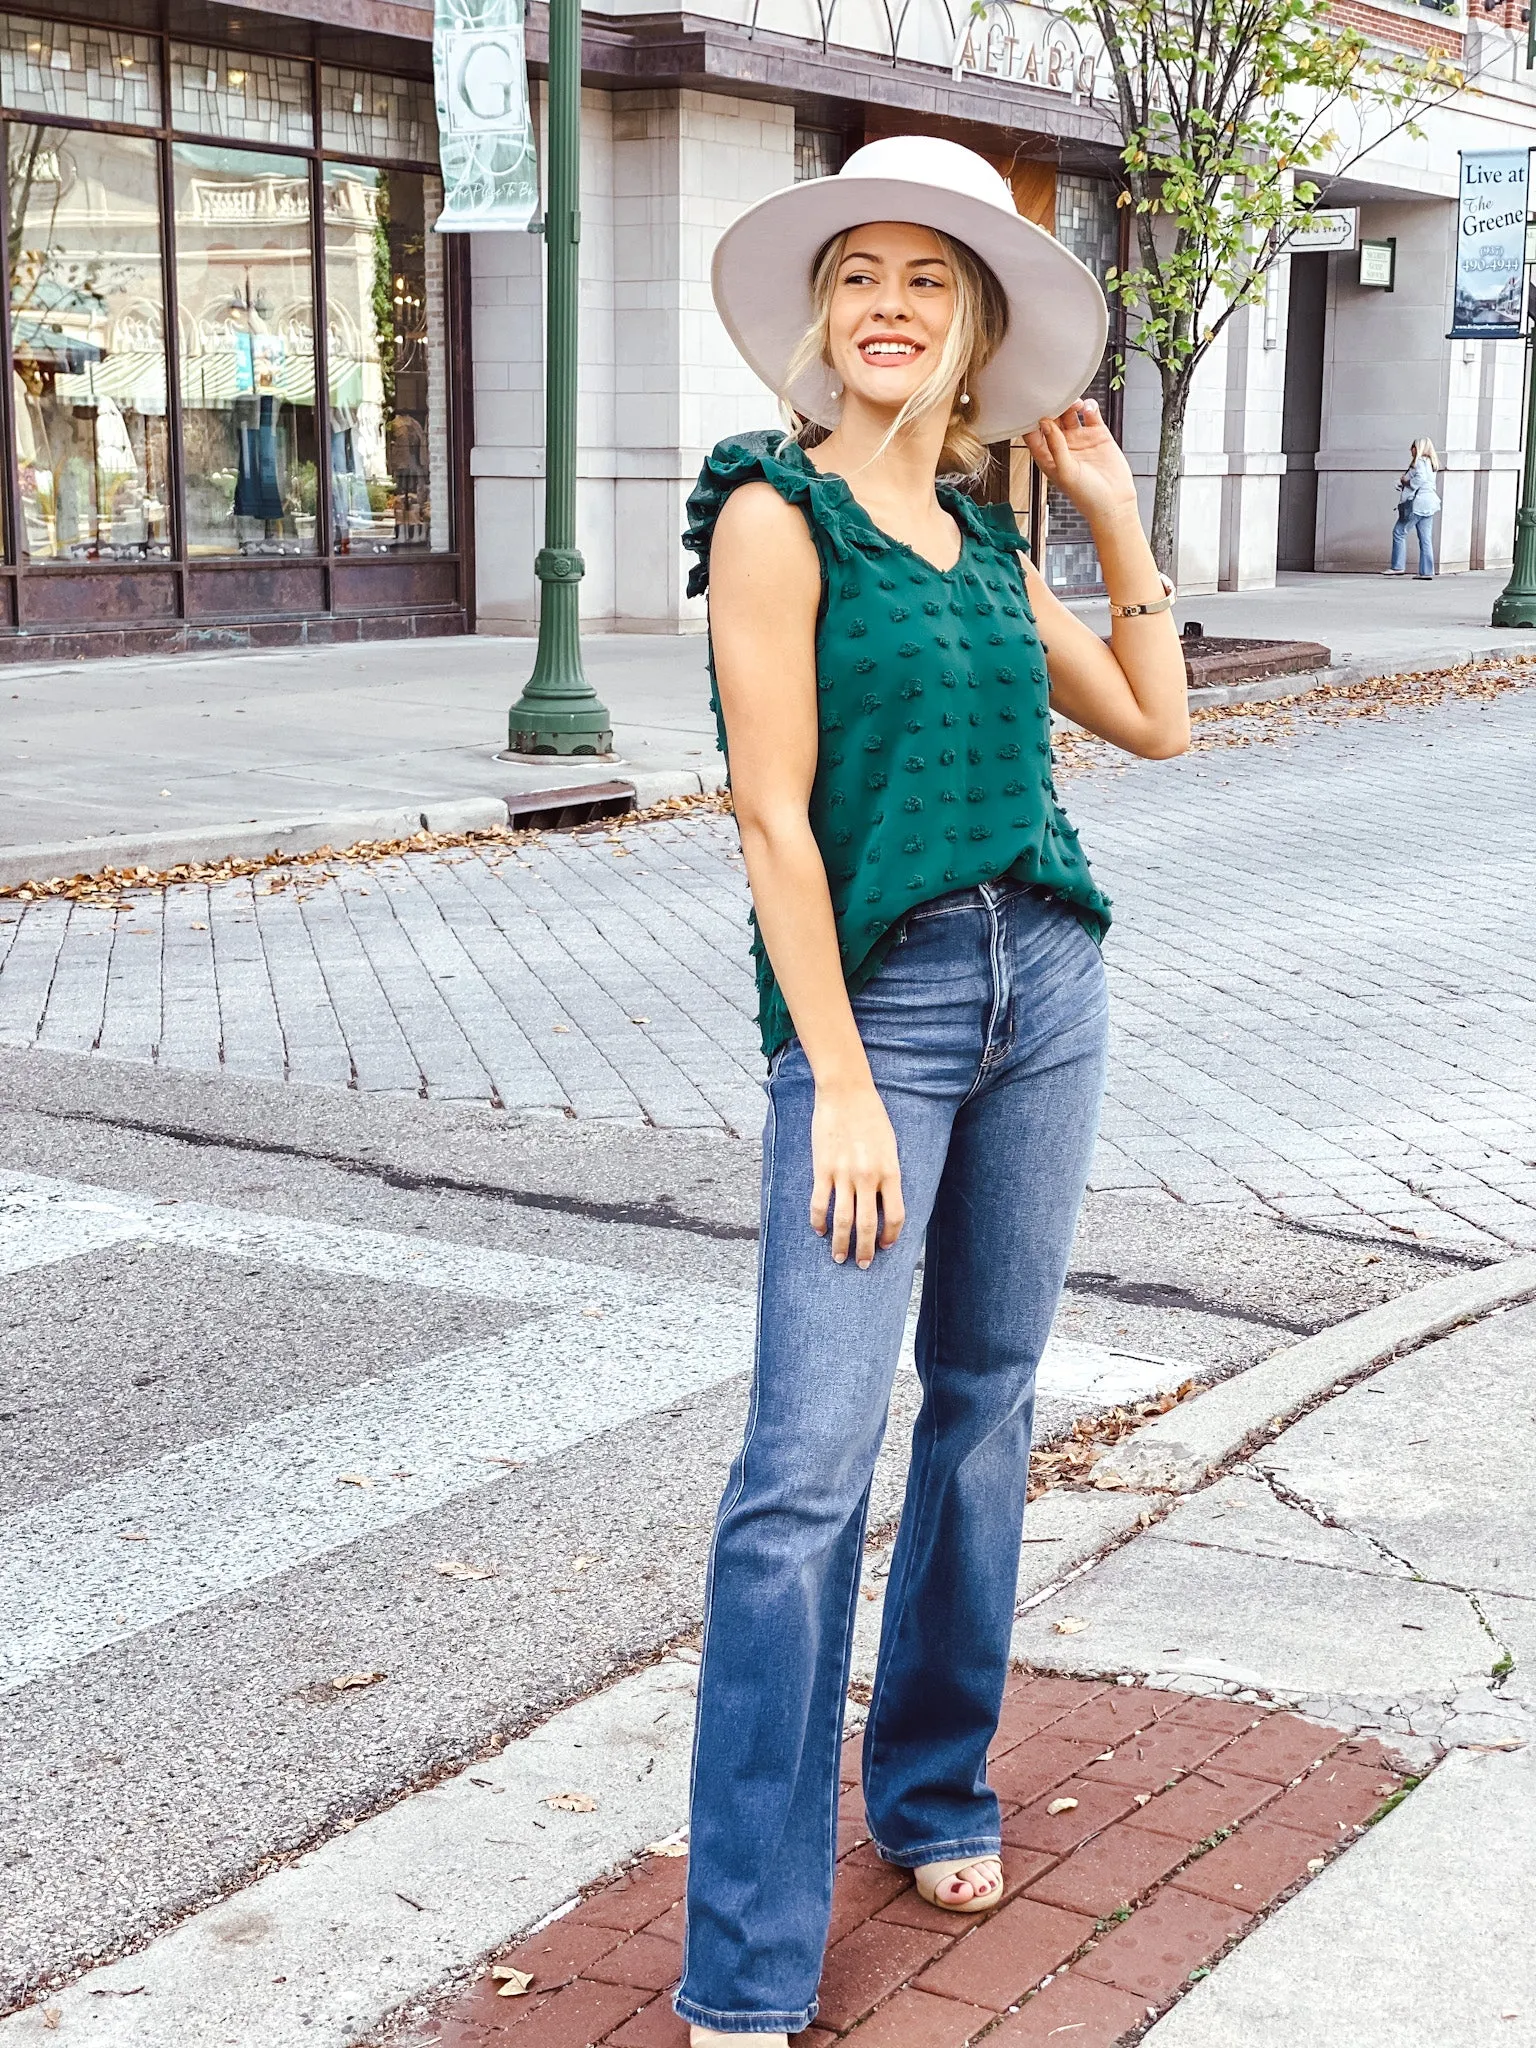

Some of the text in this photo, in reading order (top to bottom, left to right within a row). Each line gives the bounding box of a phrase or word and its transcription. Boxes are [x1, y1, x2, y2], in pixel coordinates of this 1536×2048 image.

[458, 41, 513, 120] G
[1465, 164, 1524, 184] Live at
[502, 182, 516, 202] To
[518, 181, 534, 199] Be
[1463, 195, 1494, 214] The
[1463, 209, 1524, 236] Greene
[1462, 258, 1520, 272] 490-4944
